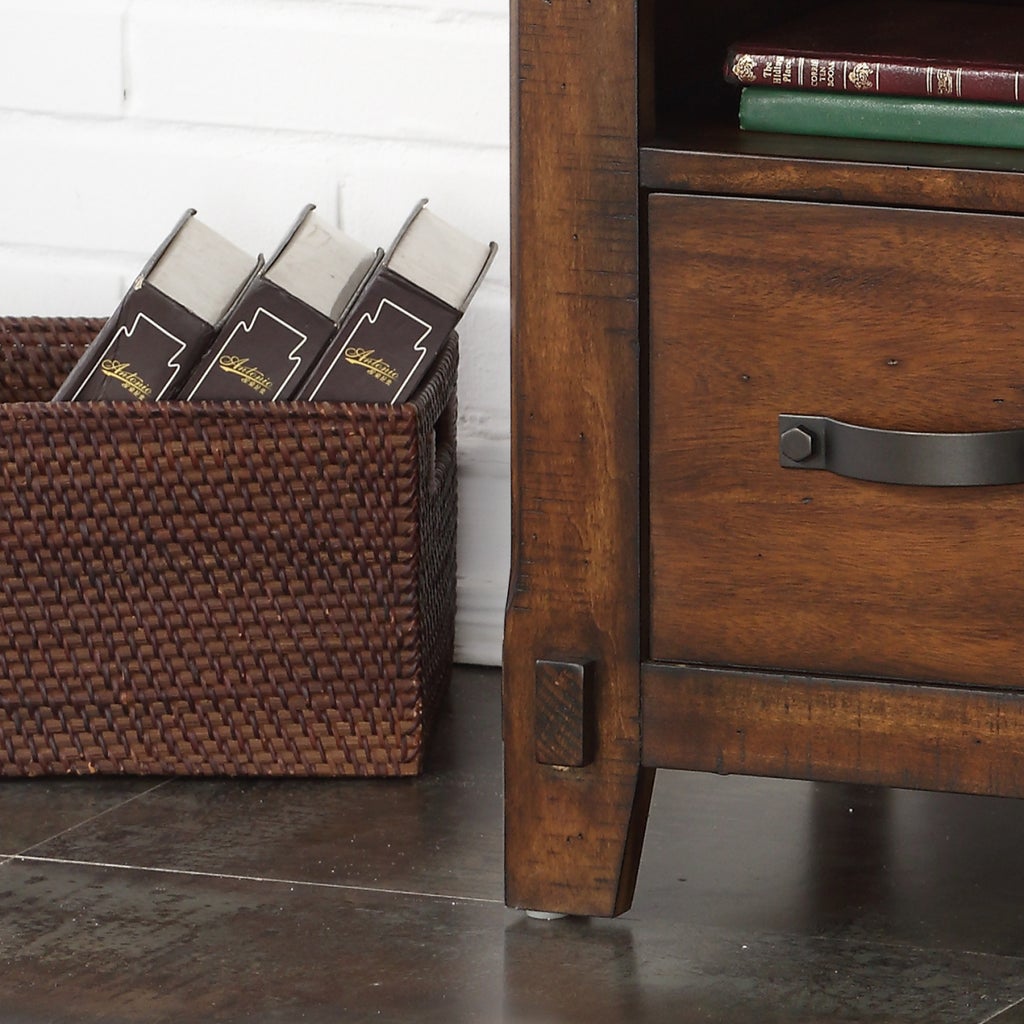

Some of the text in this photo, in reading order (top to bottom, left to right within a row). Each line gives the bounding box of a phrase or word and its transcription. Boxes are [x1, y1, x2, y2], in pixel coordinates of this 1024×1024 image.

[763, 61, 772, 79] The
[101, 359, 152, 394] Antonio
[219, 355, 273, 389] Antonio
[345, 347, 399, 379] Antonio
